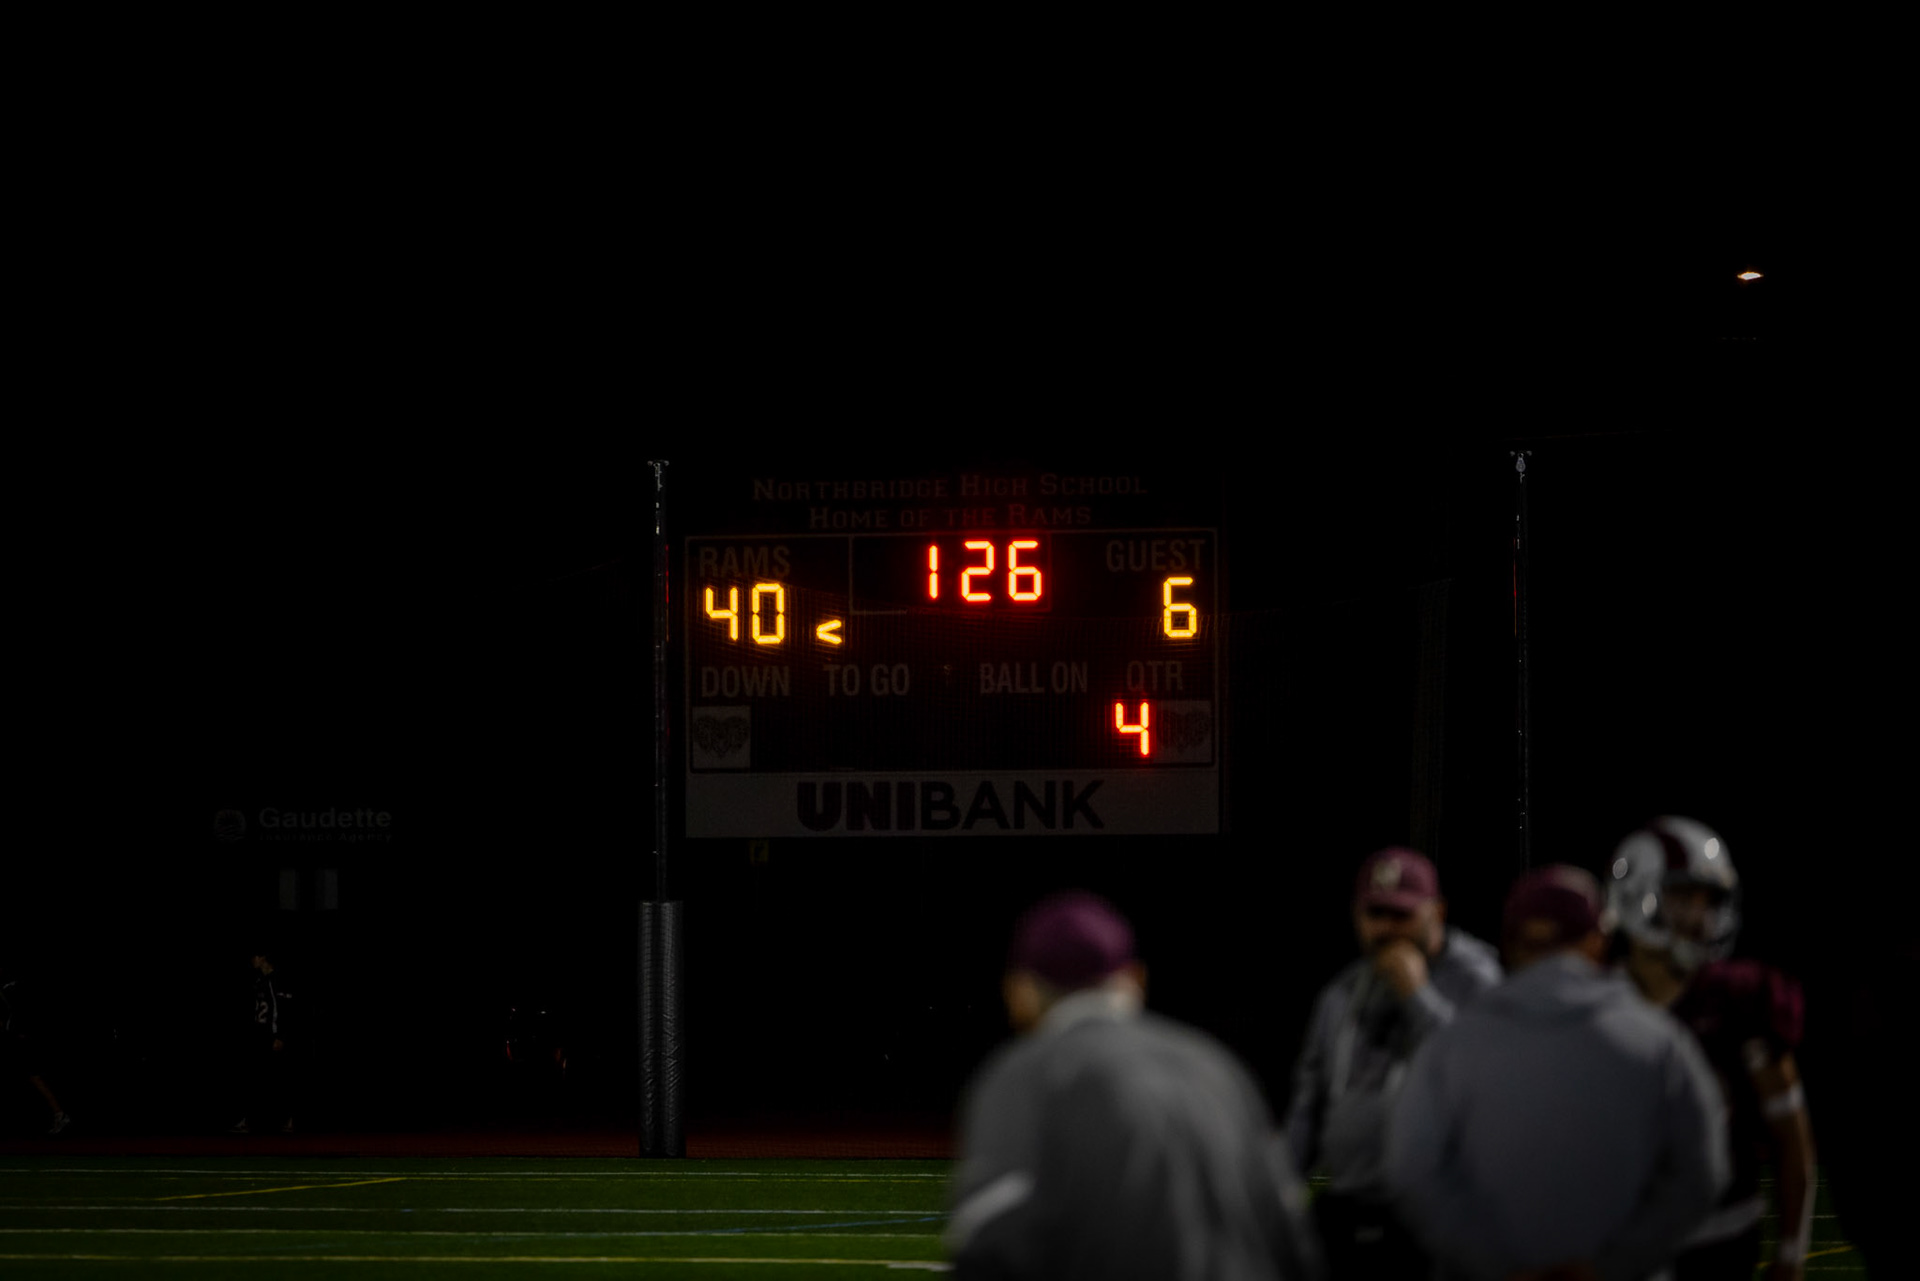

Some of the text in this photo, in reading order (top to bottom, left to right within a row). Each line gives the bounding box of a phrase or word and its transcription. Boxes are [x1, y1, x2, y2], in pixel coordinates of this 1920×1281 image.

[751, 471, 1149, 502] NORTHBRIDGE HIGH SCHOOL
[809, 503, 1093, 529] HOME OF THE RAMS
[699, 545, 791, 577] RAMS
[1105, 538, 1206, 573] GUEST
[704, 582, 786, 645] 40
[1161, 575, 1198, 639] 6
[700, 665, 790, 698] DOWN
[823, 664, 911, 697] TO GO
[979, 662, 1088, 695] BALL ON
[1125, 660, 1184, 692] QTR
[1114, 701, 1149, 756] 4
[258, 806, 393, 829] Gaudette
[797, 779, 1105, 831] UNIBANK
